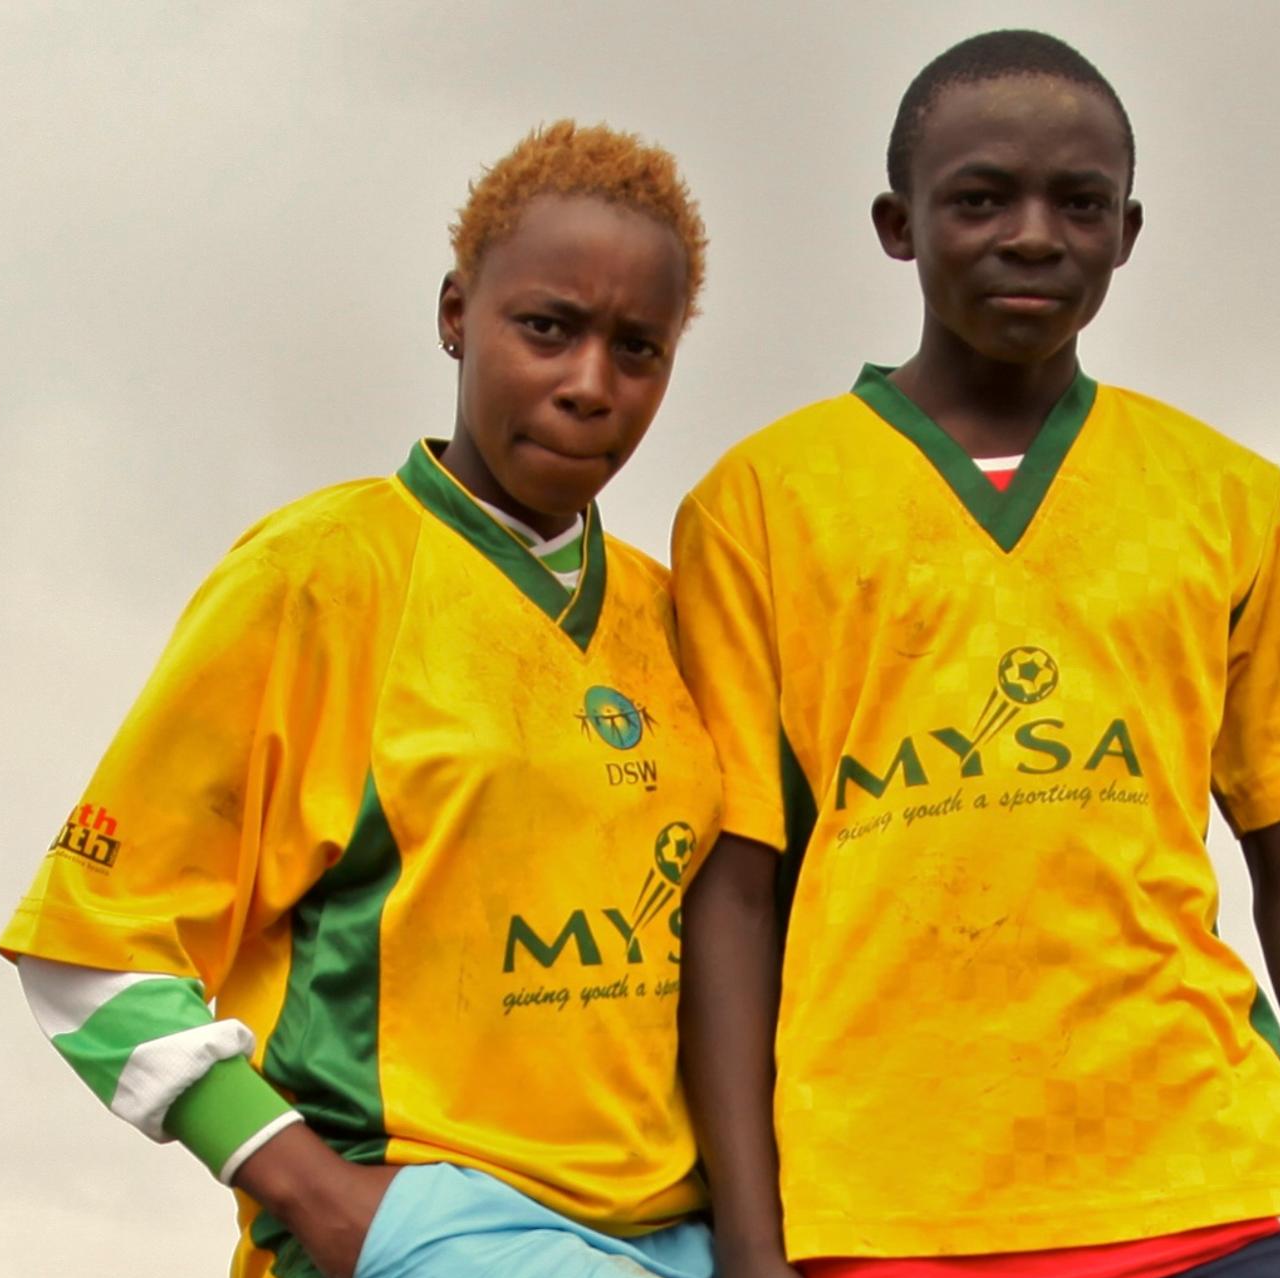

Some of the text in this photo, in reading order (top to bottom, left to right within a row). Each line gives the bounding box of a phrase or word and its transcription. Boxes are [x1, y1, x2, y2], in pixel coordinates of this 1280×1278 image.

[606, 760, 657, 787] DSW
[835, 718, 1144, 810] MYSA
[903, 787, 963, 828] youth
[973, 793, 988, 809] a
[999, 784, 1092, 812] sporting
[502, 985, 570, 1016] giving
[580, 973, 629, 1008] youth
[635, 982, 646, 997] a
